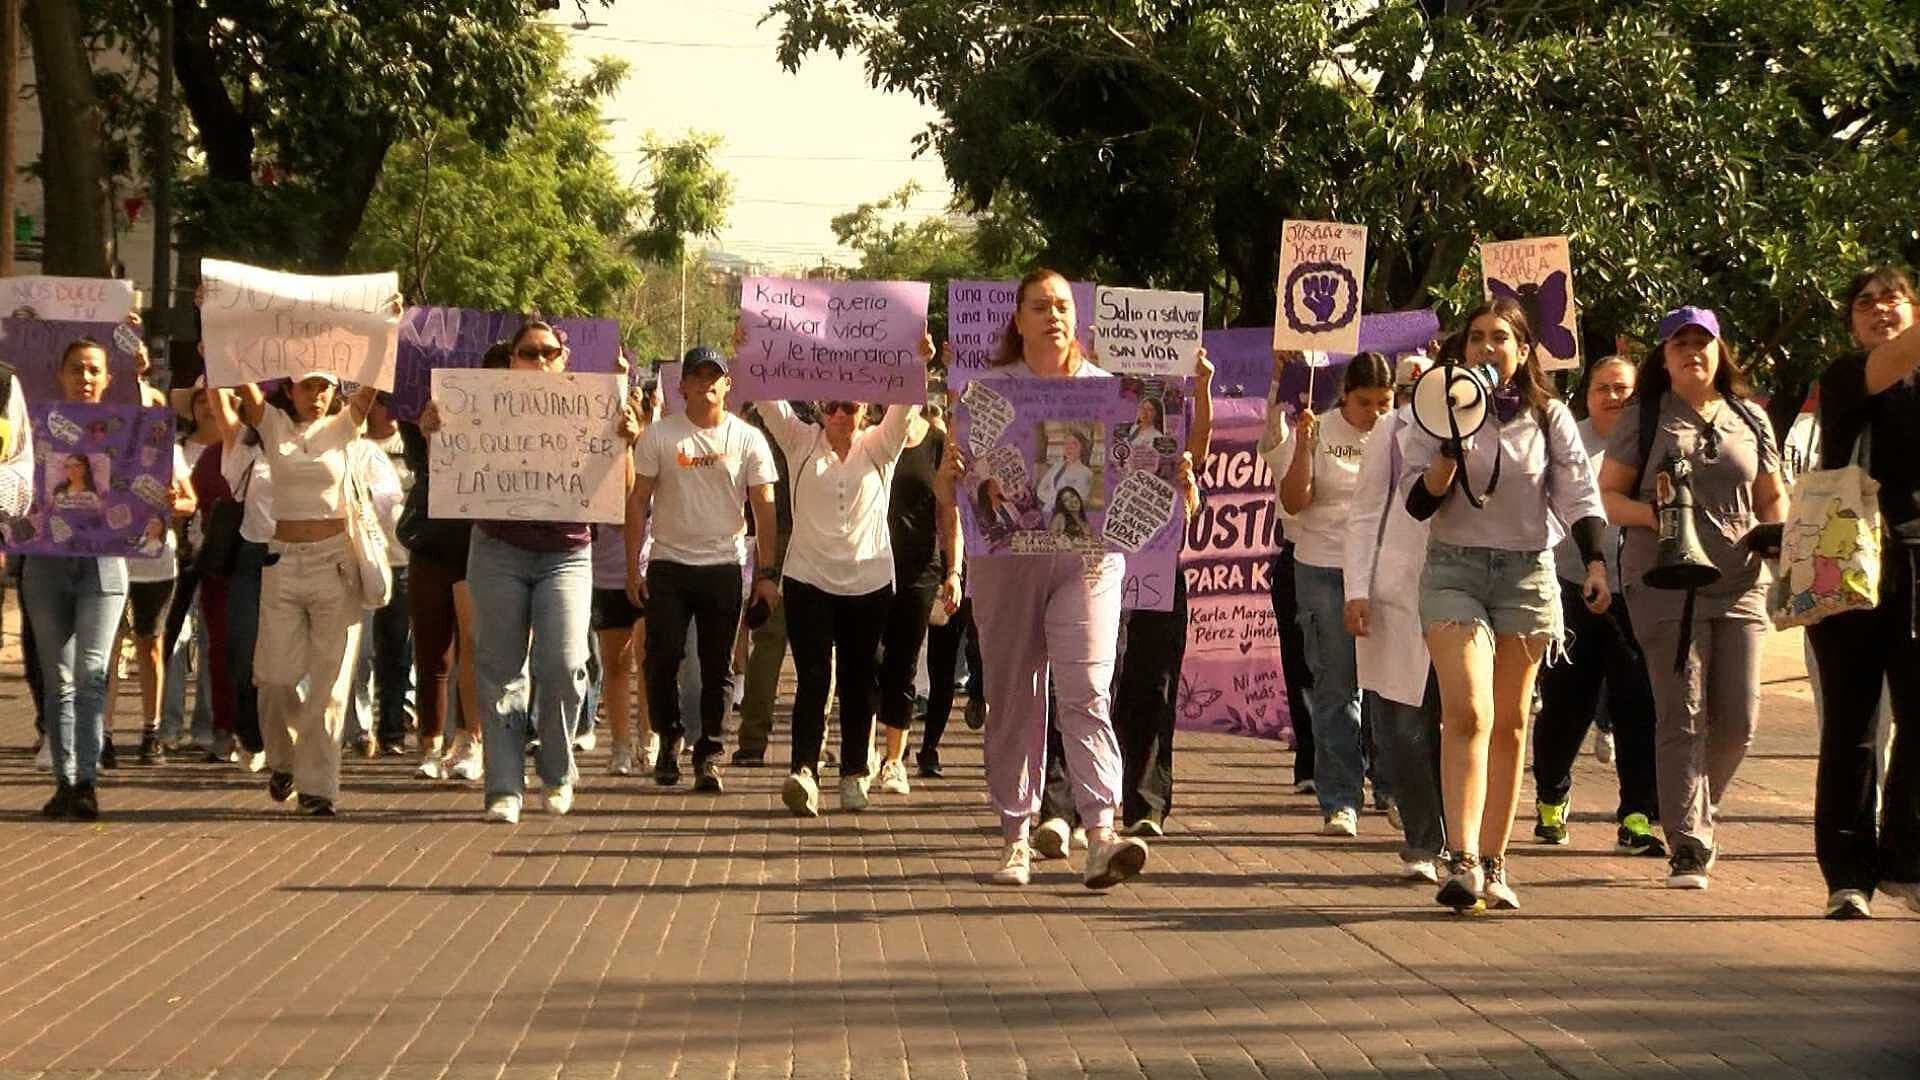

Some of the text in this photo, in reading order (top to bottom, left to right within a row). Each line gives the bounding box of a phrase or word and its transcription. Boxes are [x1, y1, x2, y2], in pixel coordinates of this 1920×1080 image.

[757, 284, 804, 307] Karla
[1099, 324, 1137, 339] vidas
[457, 472, 486, 500] LA
[1184, 564, 1244, 593] PARA
[1190, 607, 1228, 625] Karla
